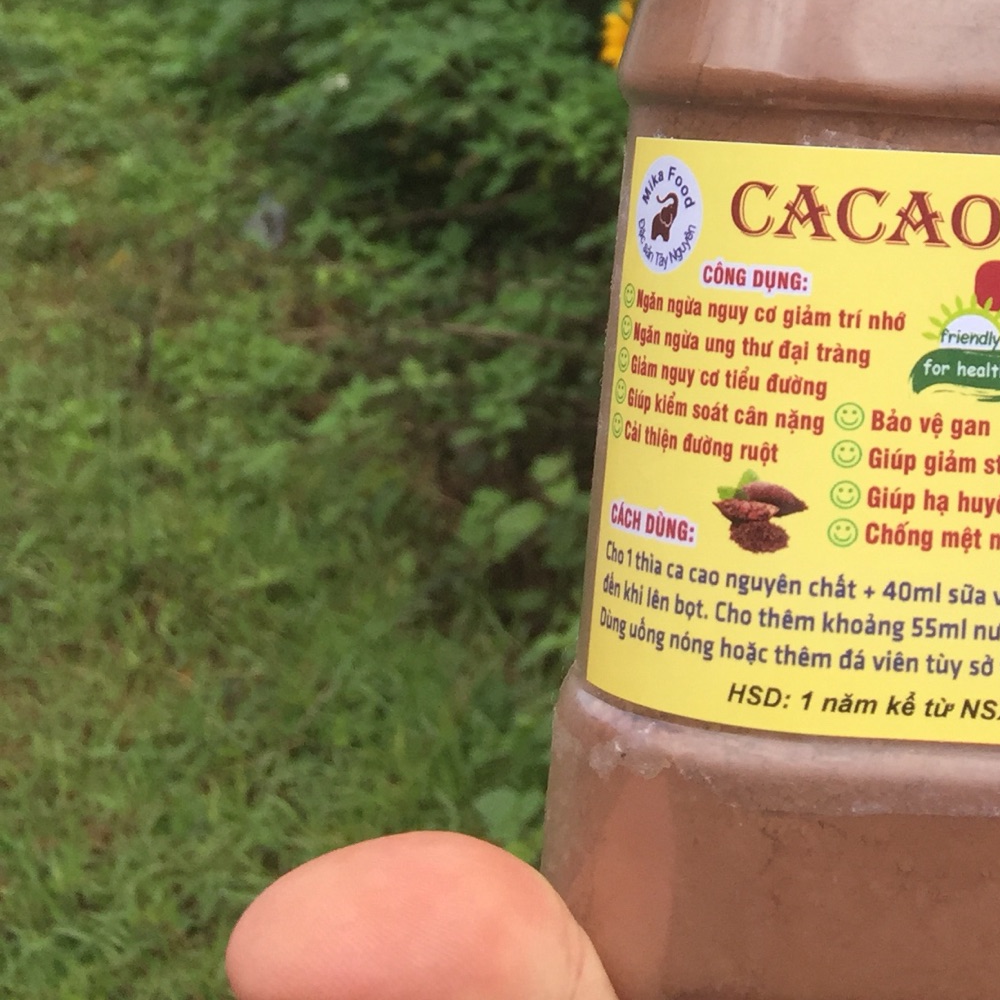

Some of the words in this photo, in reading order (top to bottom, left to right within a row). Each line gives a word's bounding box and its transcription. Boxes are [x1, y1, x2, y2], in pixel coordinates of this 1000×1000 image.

[642, 170, 664, 205] Mika
[668, 166, 695, 208] Food
[655, 251, 669, 270] Tây
[669, 224, 696, 264] Nguyên
[703, 262, 746, 286] CÔNG
[753, 269, 808, 293] DỤNG:
[636, 288, 663, 313] Ngăn
[667, 296, 701, 318] ngừa
[708, 303, 748, 325] nguy
[754, 306, 777, 323] cơ
[783, 305, 831, 328] giảm
[838, 307, 861, 328] trí
[868, 311, 906, 332] nhớ
[633, 321, 661, 346] Ngăn
[664, 328, 699, 352] ngừa
[705, 336, 735, 358] ung
[742, 337, 773, 358] thư
[778, 339, 808, 365] đại
[816, 342, 871, 369] tràng
[940, 328, 1000, 350] friendly
[630, 352, 657, 378] Giảm
[661, 364, 695, 388] nguy
[700, 369, 719, 387] cơ
[725, 366, 759, 391] tiểu
[766, 373, 827, 401] đường
[923, 358, 950, 376] for
[628, 387, 651, 415] Giúp
[655, 391, 688, 417] kiểm
[692, 402, 729, 423] soát
[734, 405, 768, 427] cân
[775, 409, 825, 435] nặng
[871, 409, 911, 433] Bảo
[920, 413, 943, 438] vệ
[950, 418, 990, 439] gan
[683, 433, 733, 462] đường
[740, 442, 778, 466] ruột
[868, 447, 916, 475] Giúp
[924, 450, 976, 476] giảm
[867, 486, 916, 514] Giúp
[923, 489, 949, 515] hạ
[611, 502, 641, 531] CÁCH
[645, 511, 694, 542] DÙNG:
[865, 522, 933, 551] Chống
[941, 527, 982, 553] mệt
[606, 540, 624, 565] Cho
[627, 548, 632, 566] 1
[666, 562, 683, 580] ca
[689, 567, 719, 586] cao
[726, 572, 801, 598] nguyên
[809, 574, 856, 599] chất
[864, 586, 875, 599] +
[883, 581, 941, 603] 40ml
[948, 583, 986, 605] sữa
[623, 580, 643, 605] khi
[647, 587, 669, 611] lên
[675, 593, 708, 620] bọt.
[715, 601, 751, 625] Cho
[759, 607, 815, 632] thêm
[822, 611, 905, 642] khoảng
[911, 617, 967, 639] 55ml
[600, 606, 626, 640] Dùng
[629, 617, 665, 651] uống
[670, 631, 715, 661] nóng
[720, 637, 768, 665] hoặc
[774, 645, 832, 669] thêm
[839, 648, 865, 671] đá
[872, 650, 919, 674] viên
[926, 653, 963, 680] tùy
[969, 654, 994, 677] sở
[727, 682, 791, 709] HSD:
[801, 691, 813, 711] 1
[821, 693, 878, 715] năm
[886, 691, 917, 716] kể
[924, 697, 954, 718] từ
